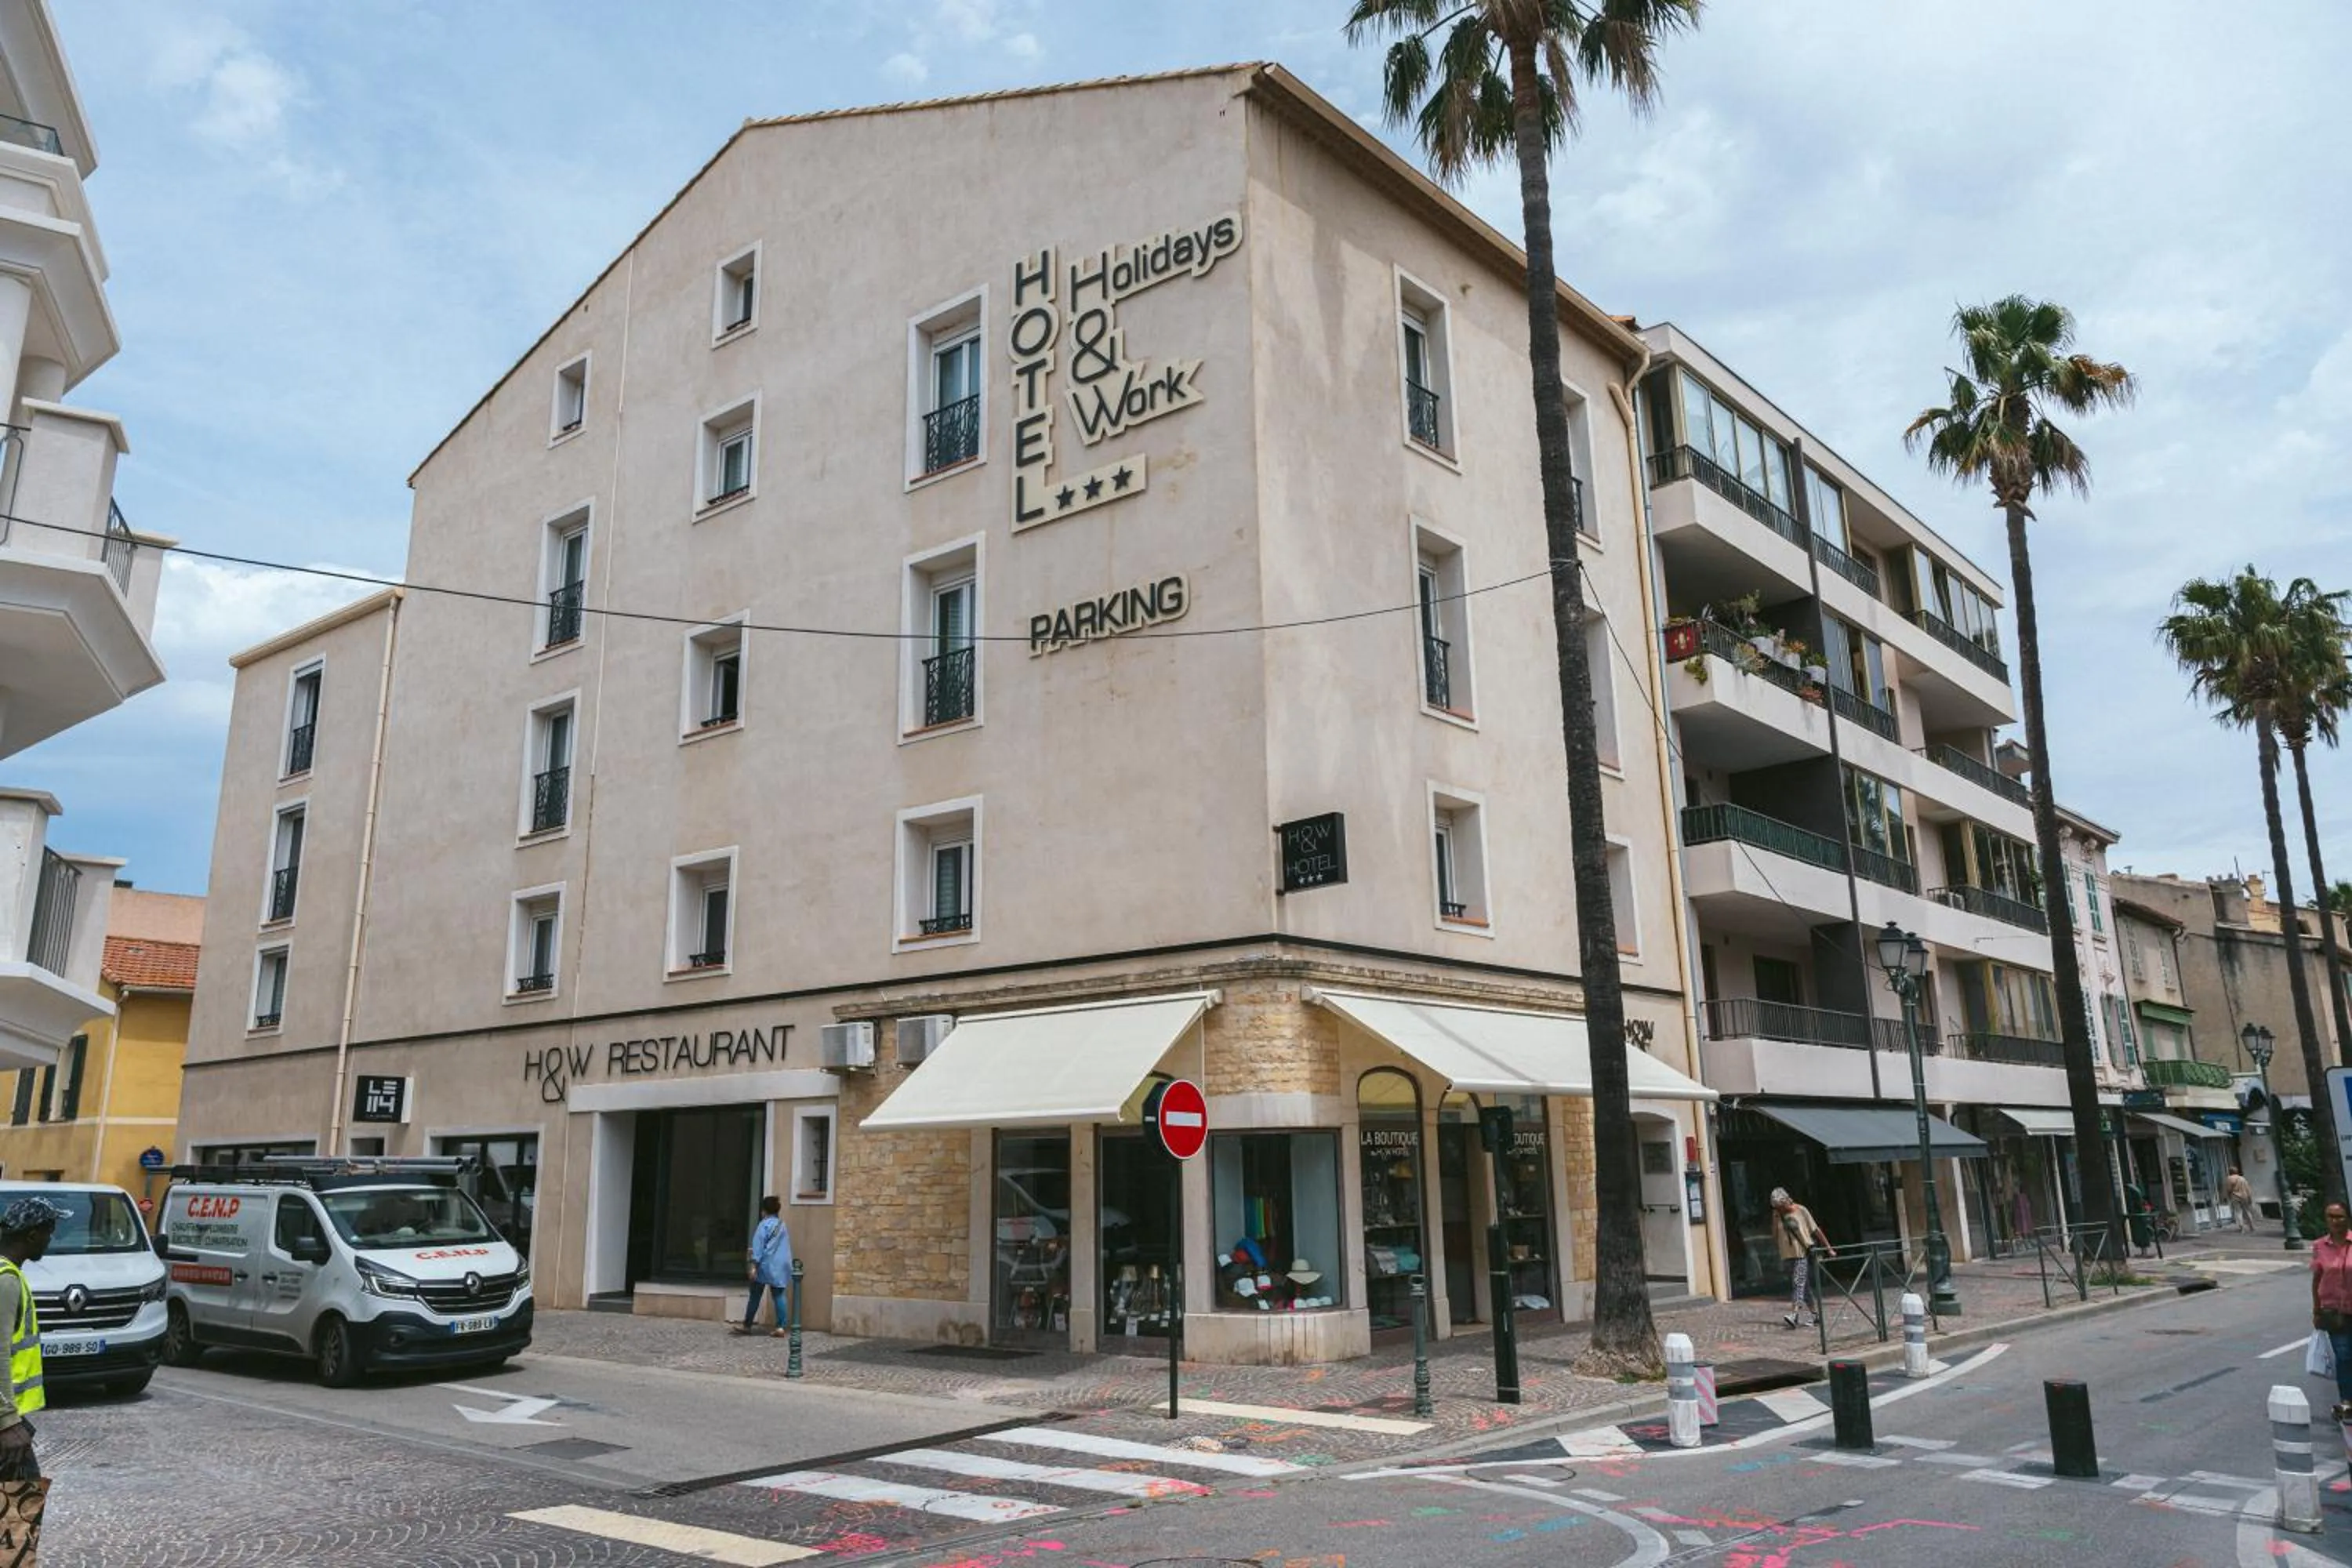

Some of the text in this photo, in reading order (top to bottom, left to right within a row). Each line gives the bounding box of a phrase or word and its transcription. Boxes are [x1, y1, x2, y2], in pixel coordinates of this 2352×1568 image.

[1071, 216, 1234, 313] Holidays
[1072, 307, 1120, 384] &
[1011, 249, 1054, 523] HOTEL
[1073, 366, 1189, 437] Work
[1029, 576, 1184, 652] PARKING
[1287, 854, 1337, 877] HOTEL
[524, 1024, 795, 1103] H&W RESTAURANT
[1360, 1131, 1418, 1147] LA BOUTIQUE
[1513, 1132, 1544, 1147] OUTIQUE
